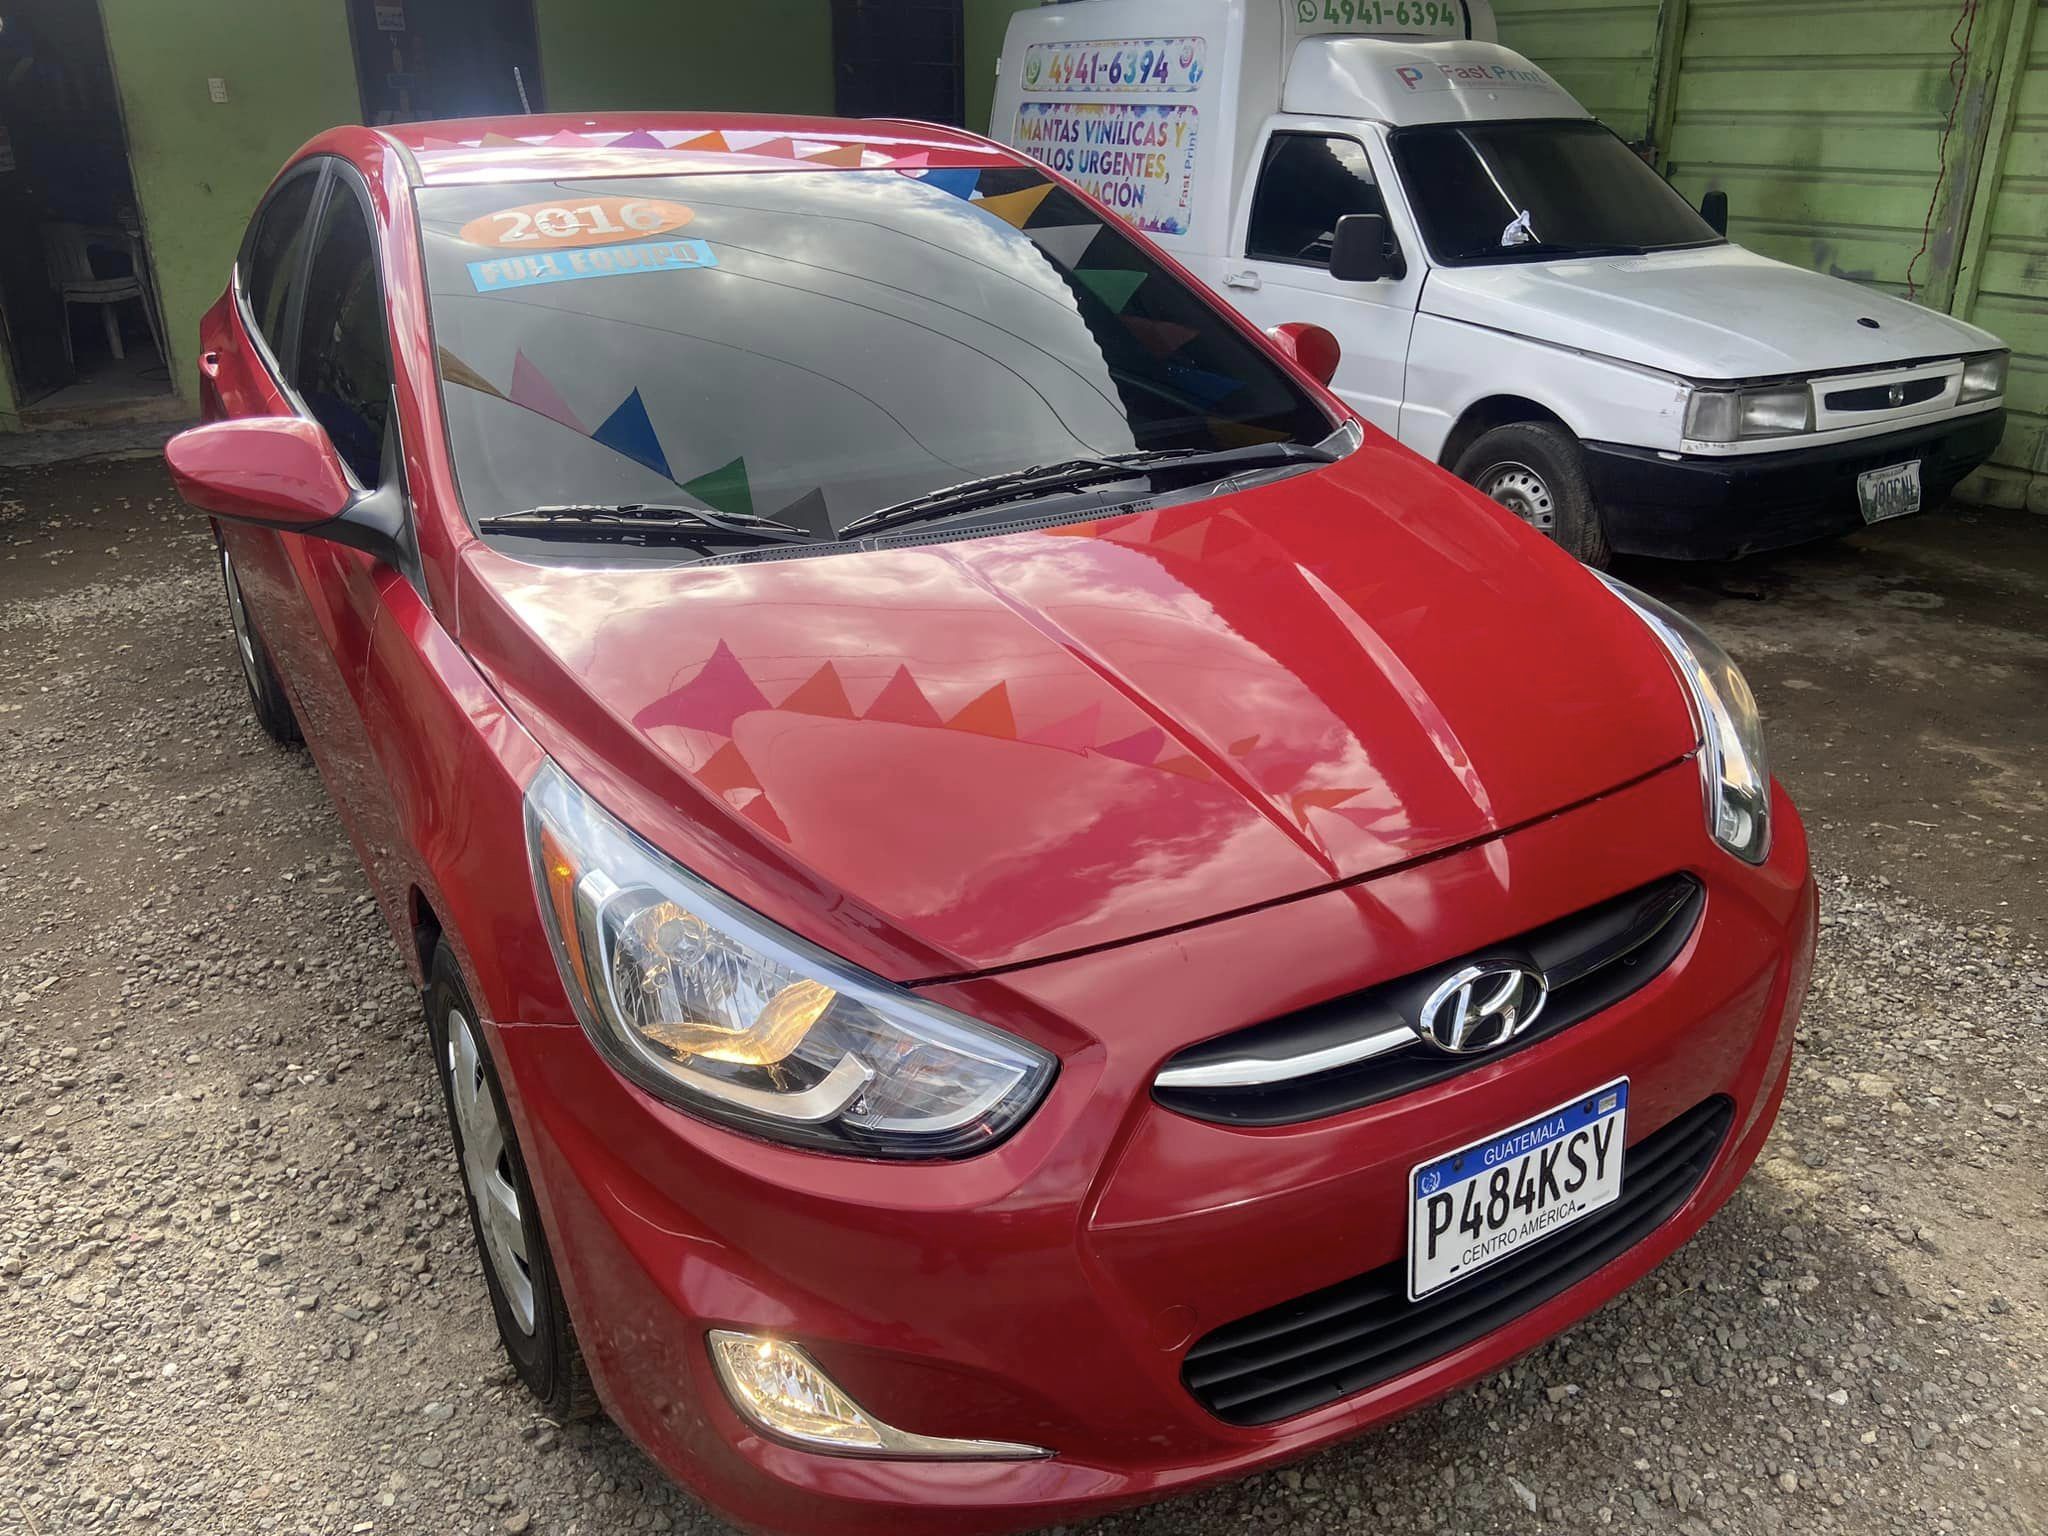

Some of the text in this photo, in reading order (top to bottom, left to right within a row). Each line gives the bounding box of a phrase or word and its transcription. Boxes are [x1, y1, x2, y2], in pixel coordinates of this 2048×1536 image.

[1323, 0, 1455, 26] 4941-6394
[1049, 49, 1169, 84] 4941-6394
[1438, 64, 1493, 79] Fast
[1020, 114, 1187, 148] MANTAS VINÍLICAS Y
[1079, 150, 1170, 184] URGENTES,
[492, 202, 665, 243] 2016
[480, 242, 700, 285] FULL EQUIPO
[1483, 1117, 1566, 1165] GUATEMALA
[1427, 1116, 1615, 1260] P484KSY
[1462, 1200, 1577, 1266] CENTRO AMÉRICA
